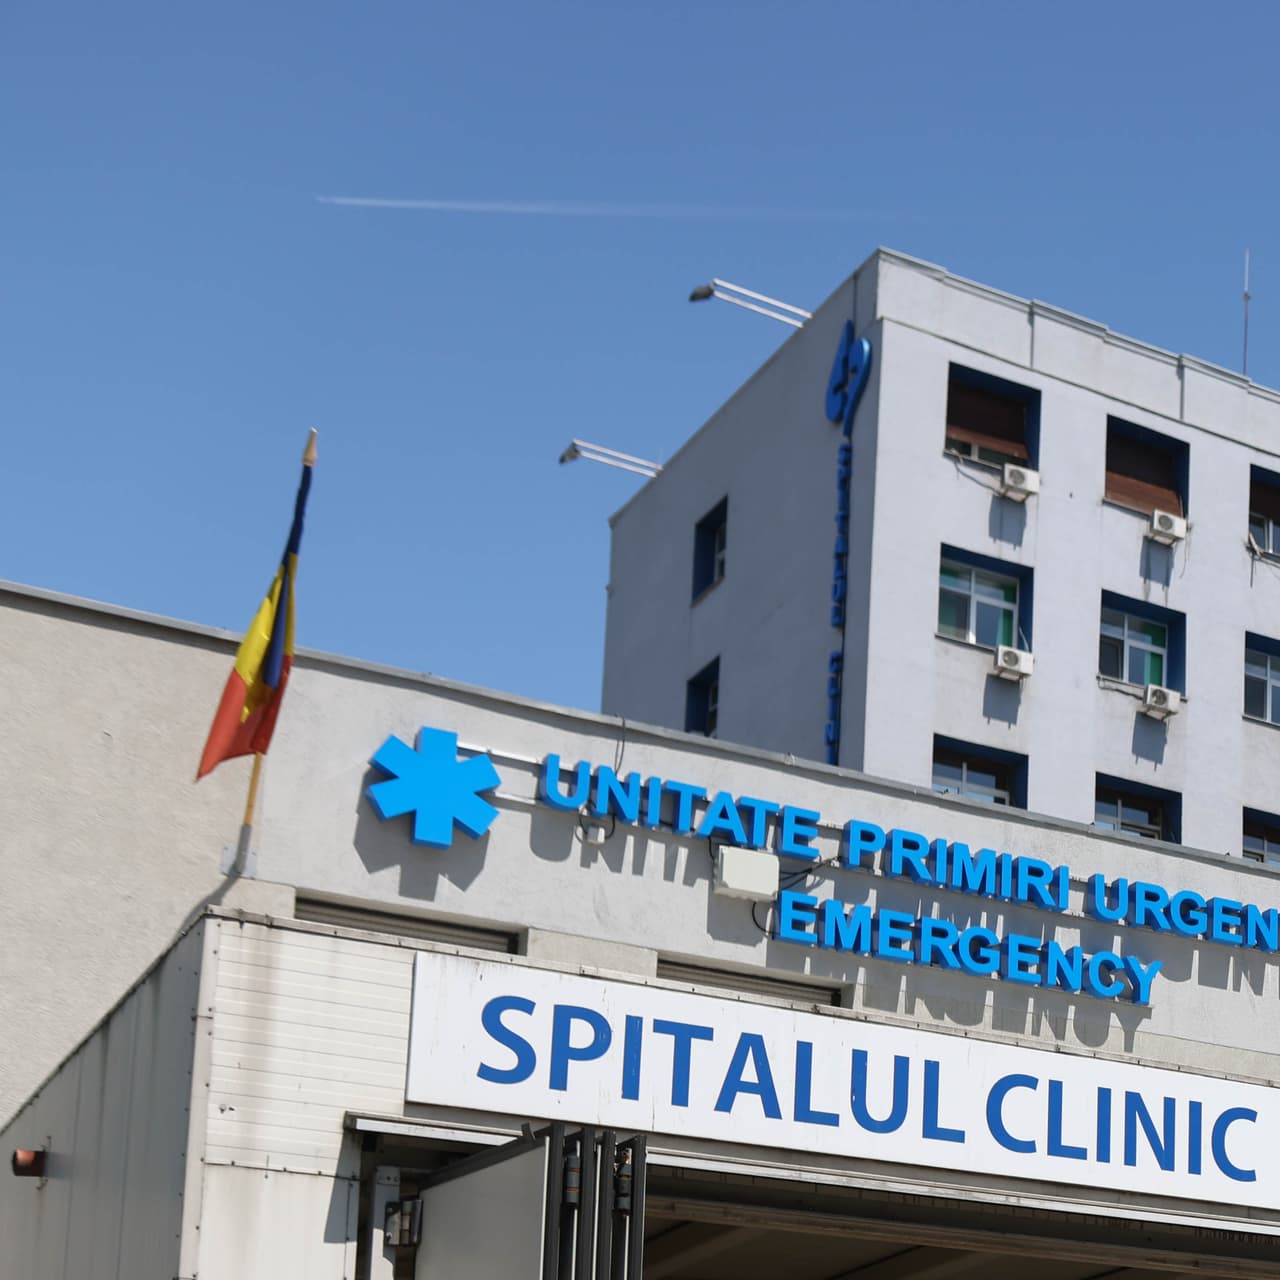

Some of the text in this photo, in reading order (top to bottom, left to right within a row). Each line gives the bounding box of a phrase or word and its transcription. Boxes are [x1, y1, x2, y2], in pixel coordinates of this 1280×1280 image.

[540, 752, 822, 862] UNITATE
[842, 818, 1072, 914] PRIMIRI
[774, 887, 1165, 1006] EMERGENCY
[477, 995, 966, 1144] SPITALUL
[986, 1073, 1258, 1183] CLINIC
